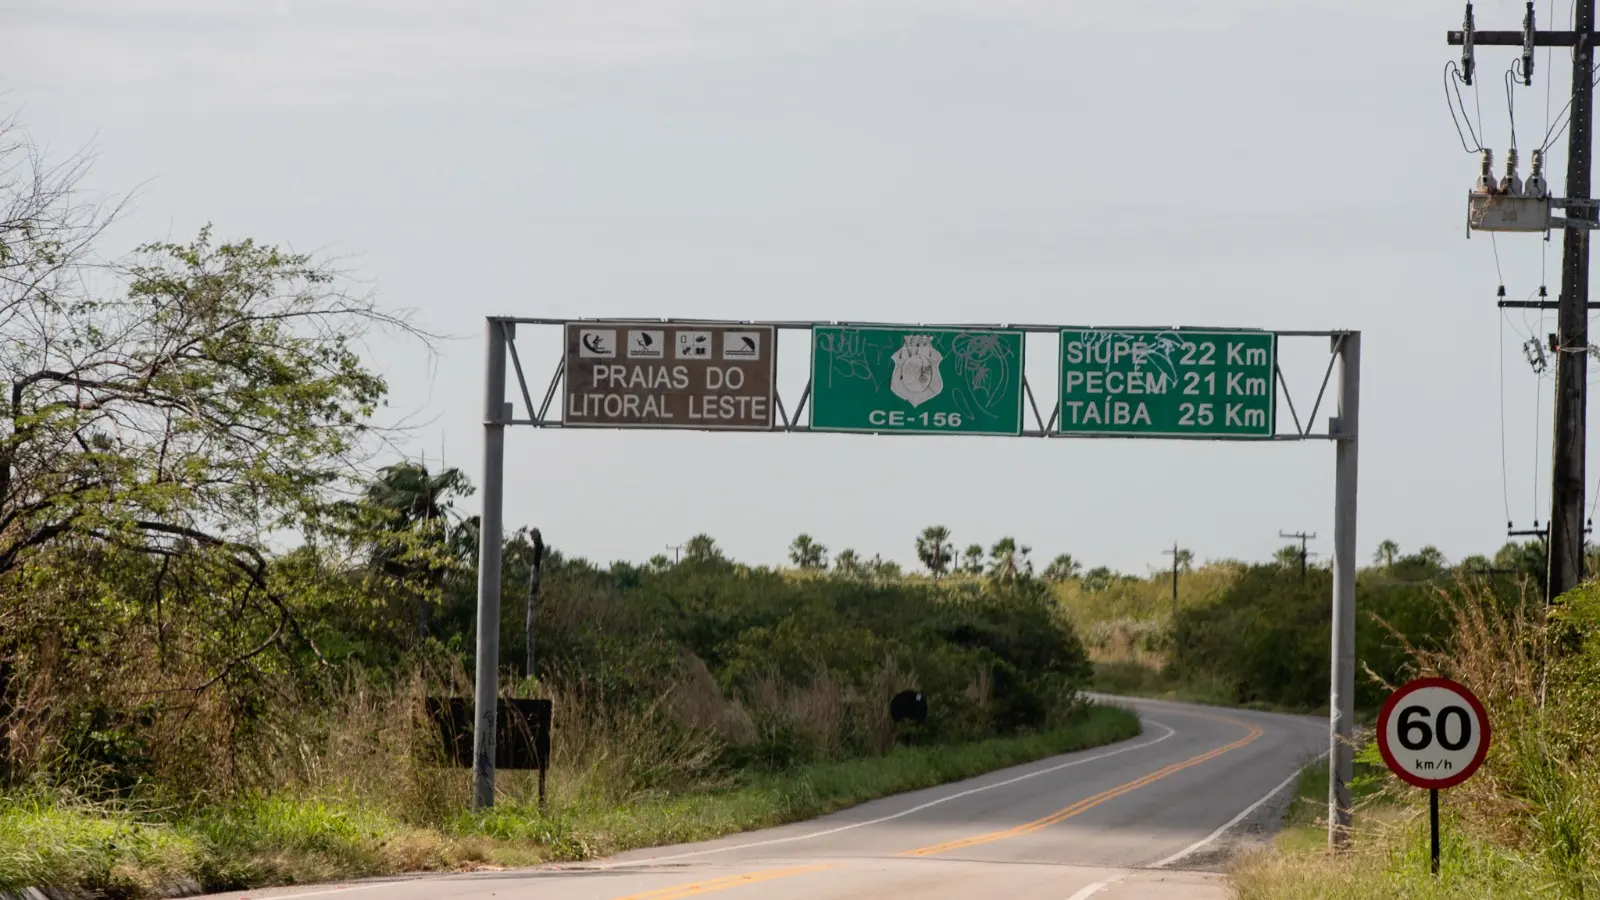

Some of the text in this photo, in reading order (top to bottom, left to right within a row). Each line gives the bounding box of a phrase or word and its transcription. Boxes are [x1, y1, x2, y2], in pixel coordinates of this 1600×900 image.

[1066, 335, 1148, 364] SIUPÉ
[1179, 342, 1216, 365] 22
[1226, 342, 1267, 366] Km
[592, 365, 745, 390] PRAIAS DO
[1183, 372, 1216, 396] 21
[1226, 372, 1267, 396] Km
[569, 393, 767, 420] LITORAL LESTE
[868, 410, 962, 427] CE-156
[1066, 395, 1265, 428] TAÍBA 25 Km
[1397, 705, 1472, 751] 60
[1415, 759, 1452, 770] km/h
